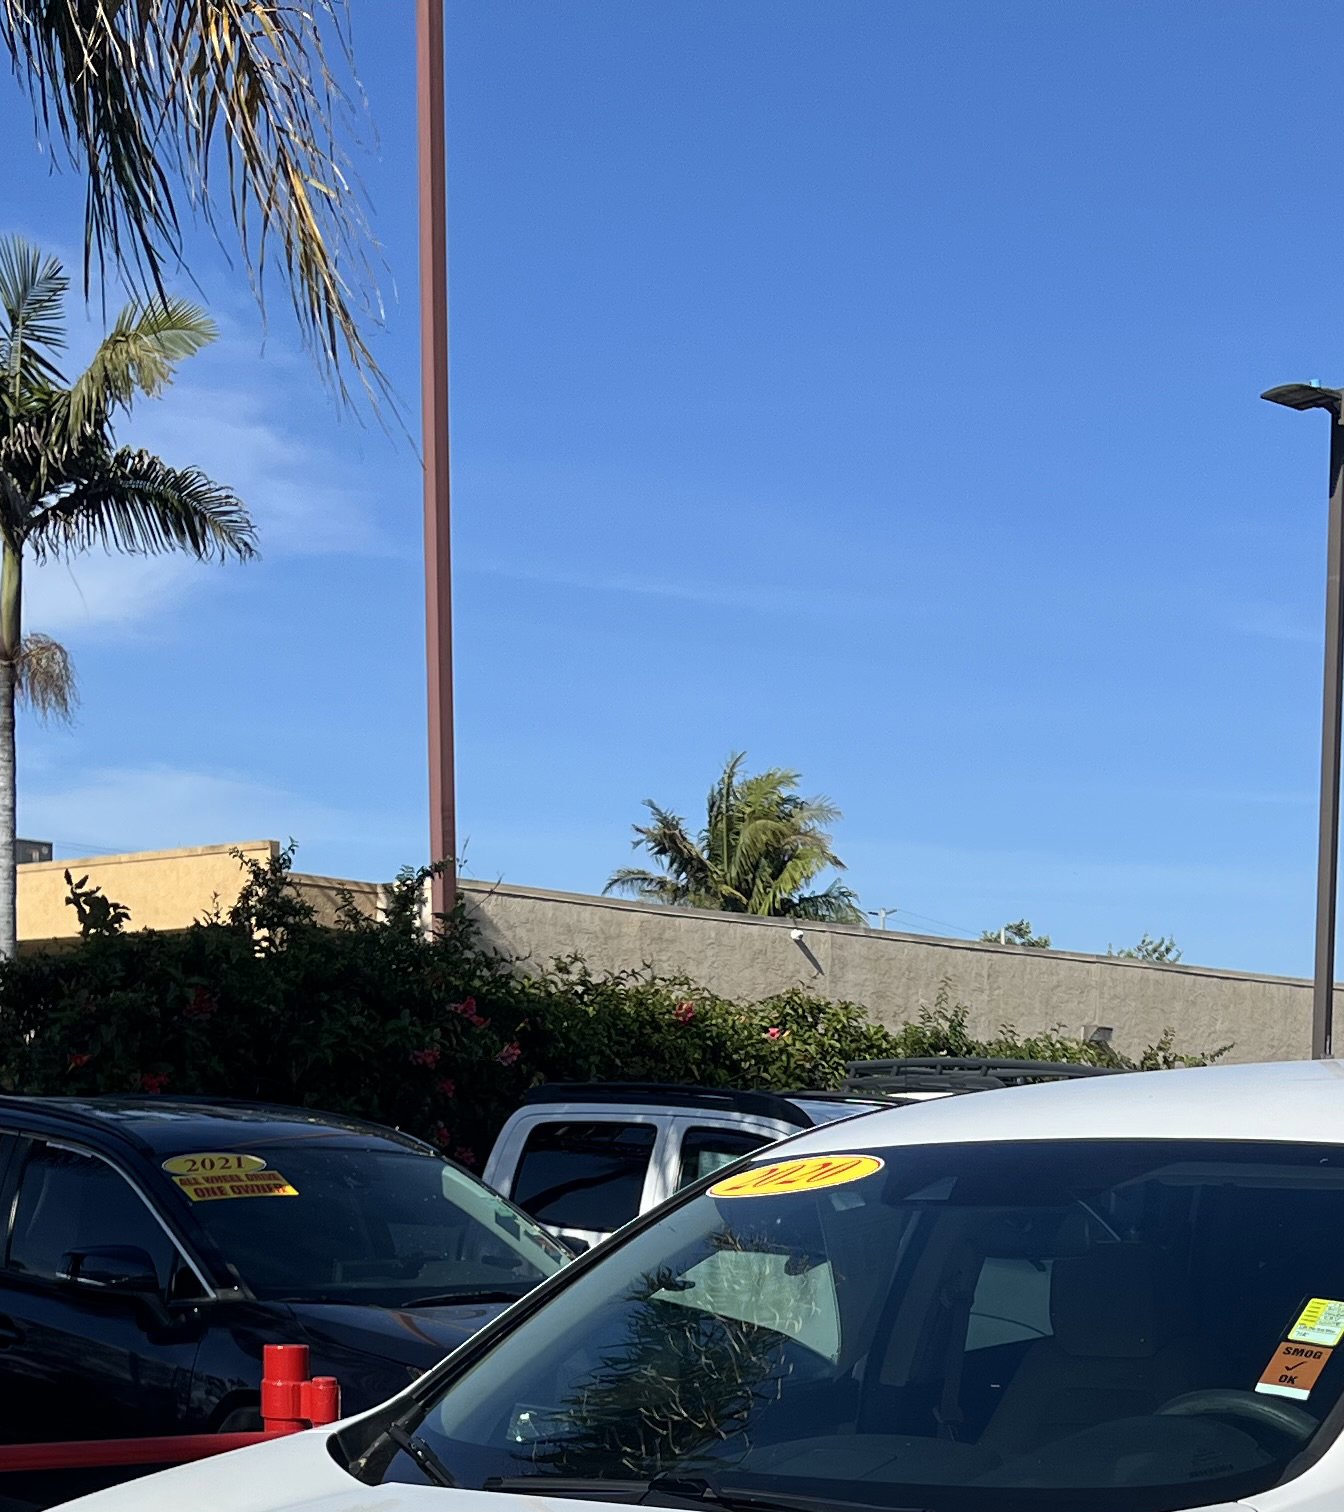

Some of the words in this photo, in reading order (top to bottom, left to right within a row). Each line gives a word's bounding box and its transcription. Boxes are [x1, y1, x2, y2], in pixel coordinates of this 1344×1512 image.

[185, 1156, 244, 1173] 2021
[179, 1177, 200, 1187] ALL
[203, 1174, 244, 1185] WHEEL
[722, 1158, 863, 1192] 2020
[194, 1187, 227, 1198] ONE
[230, 1184, 288, 1196] OWNER
[1282, 1346, 1323, 1360] SMOG
[1278, 1374, 1298, 1385] OK
